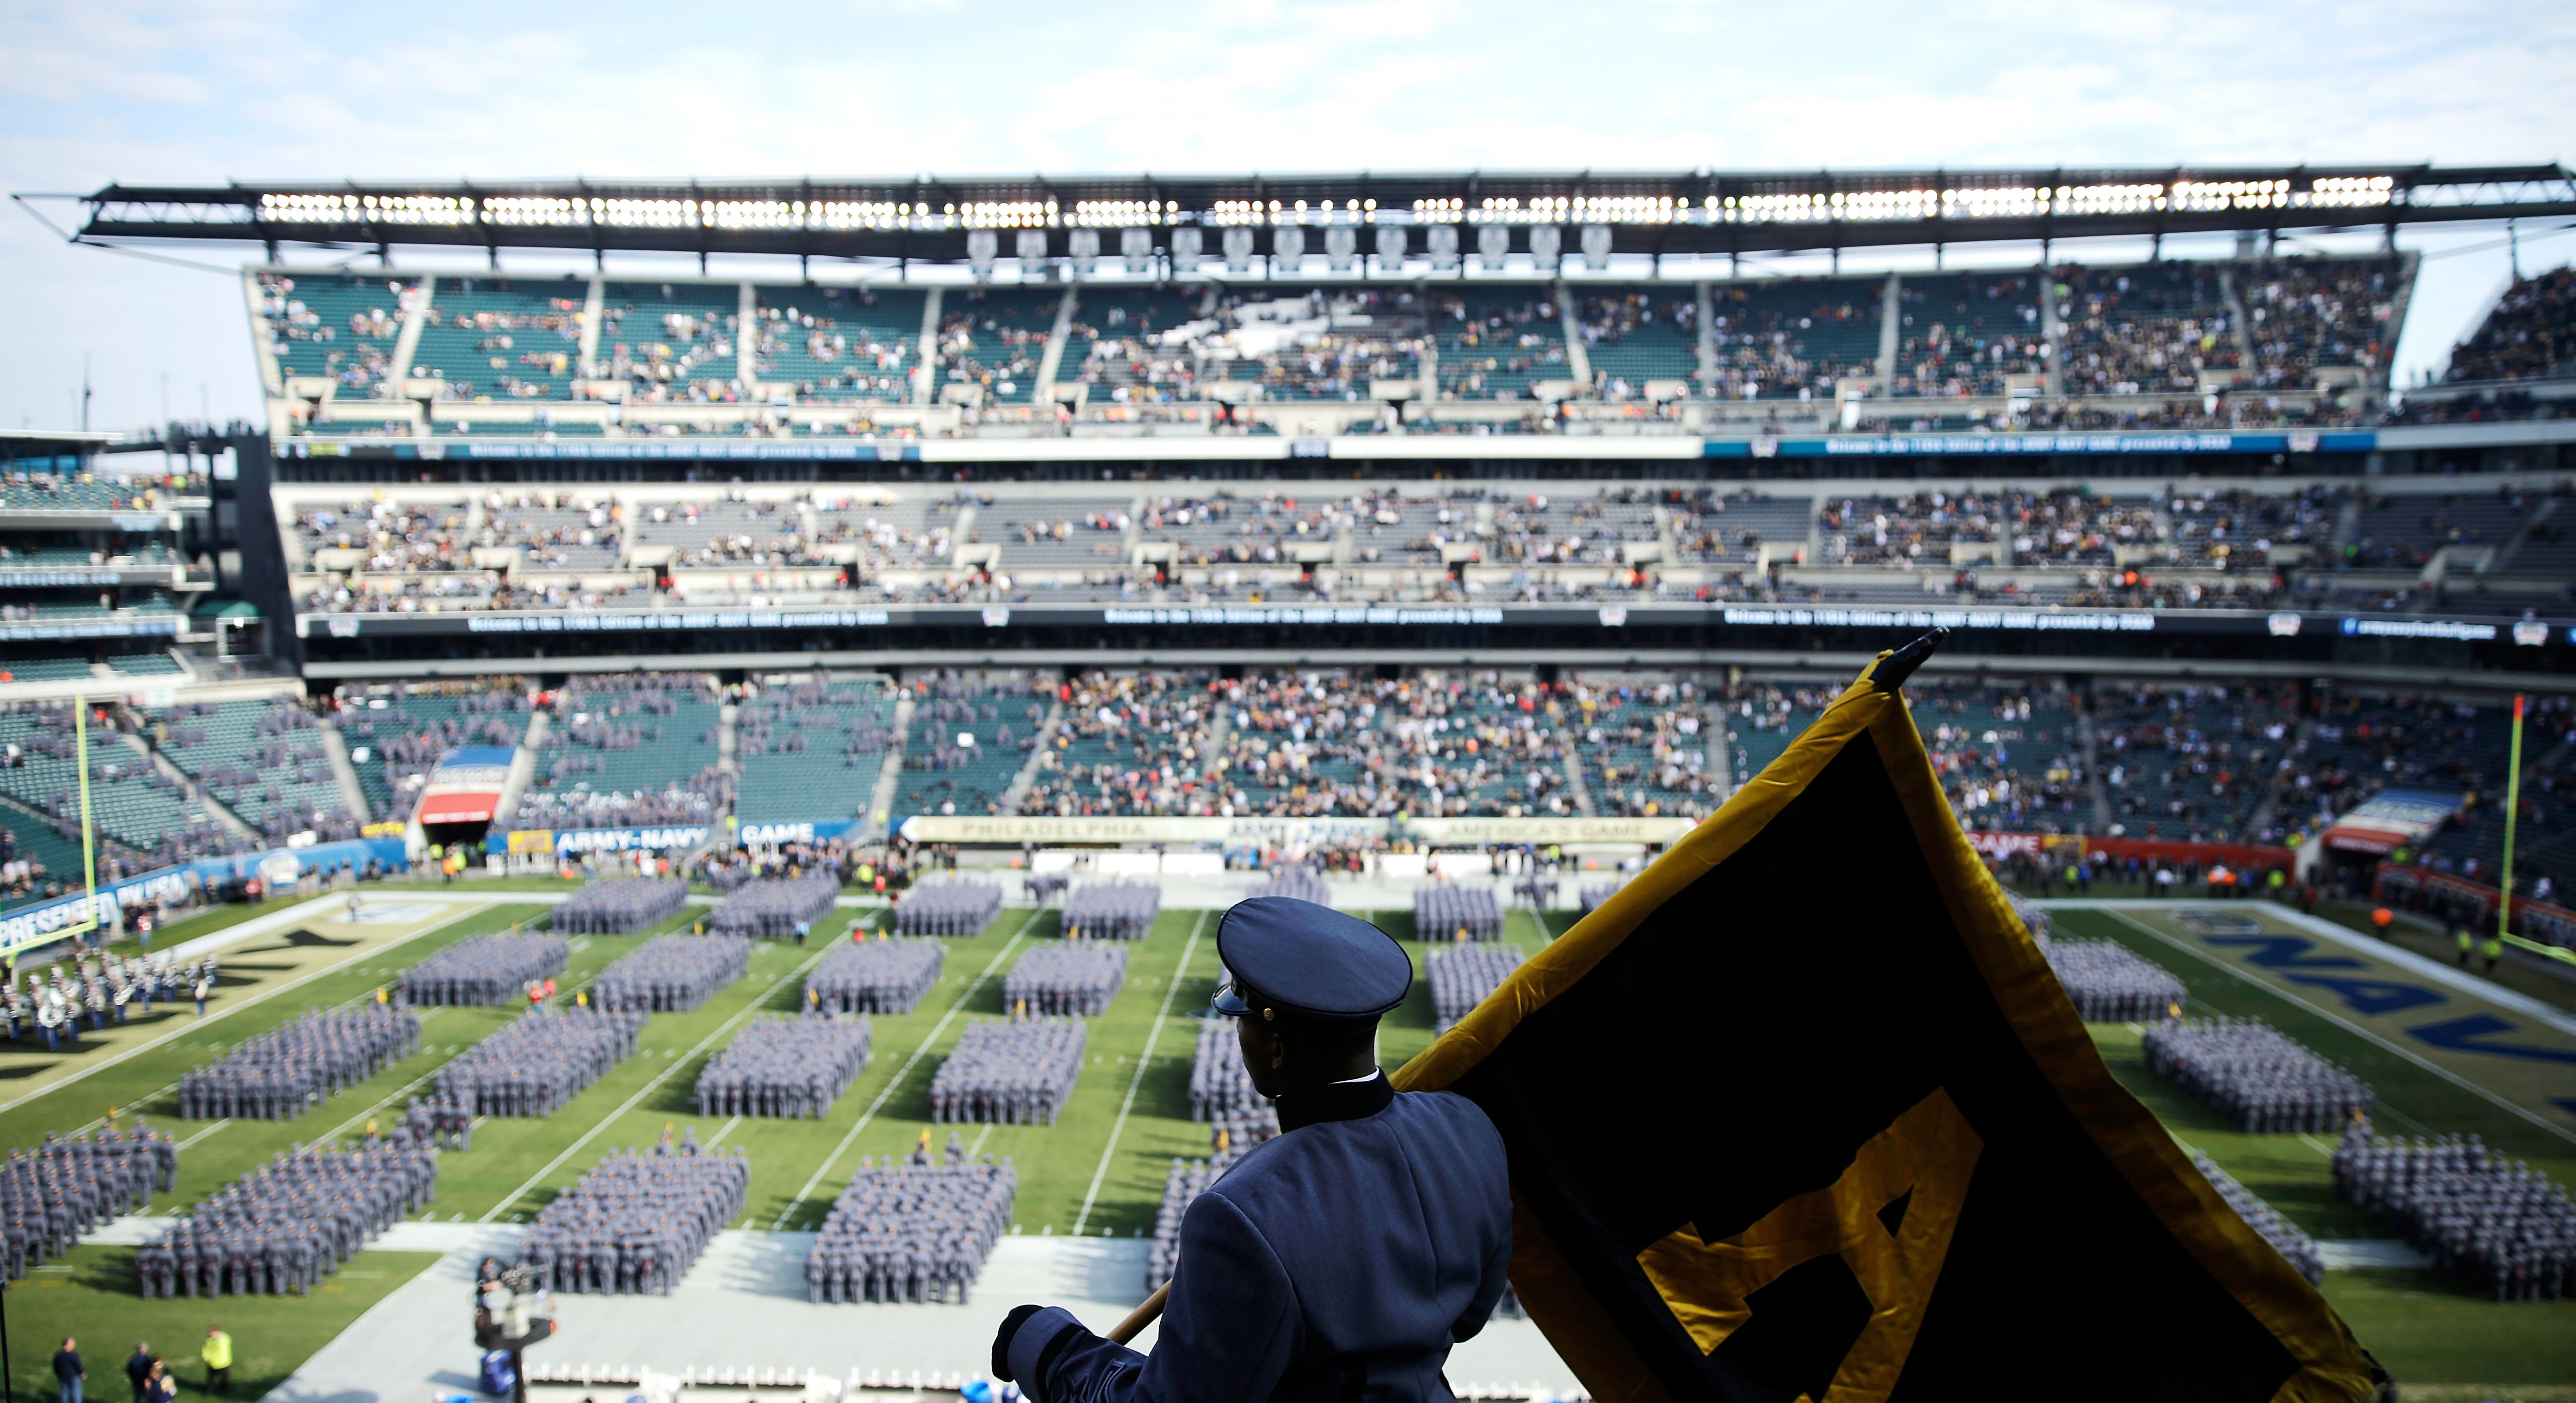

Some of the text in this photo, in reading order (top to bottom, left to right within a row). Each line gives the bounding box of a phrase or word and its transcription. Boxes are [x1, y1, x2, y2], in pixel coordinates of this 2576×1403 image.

[558, 827, 708, 852] ARMY-NAVY
[740, 822, 814, 844] GAME
[962, 823, 1145, 836] PHILADELPHIA
[1579, 823, 1643, 836] GAME
[2201, 935, 2576, 1118] NAV
[1635, 1085, 1986, 1403] A
